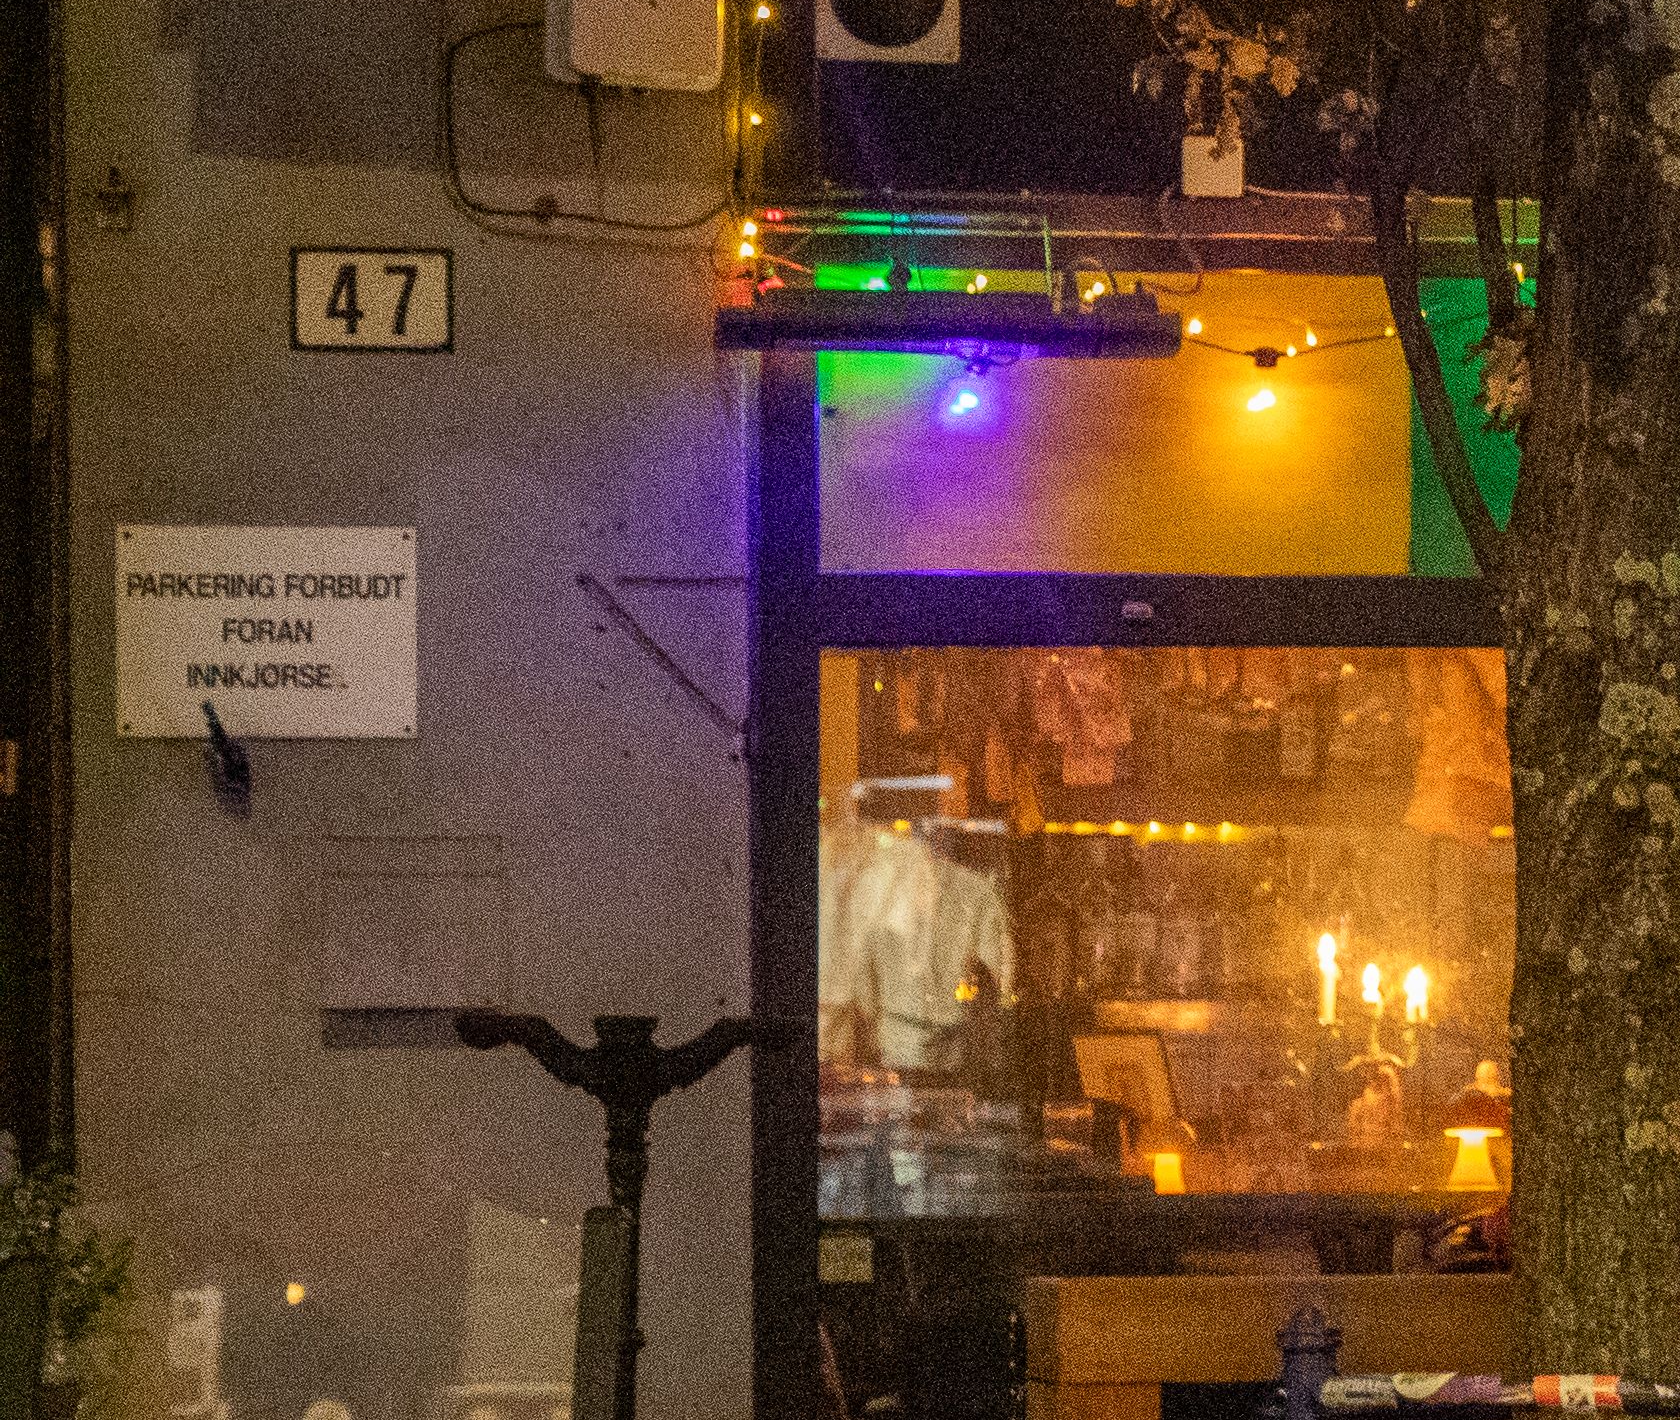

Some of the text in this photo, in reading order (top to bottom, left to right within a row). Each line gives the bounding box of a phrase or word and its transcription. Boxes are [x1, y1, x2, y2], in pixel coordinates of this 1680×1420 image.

[325, 264, 420, 335] 47
[126, 573, 406, 599] PARKERING FORBUDT
[222, 619, 314, 644] FORAN
